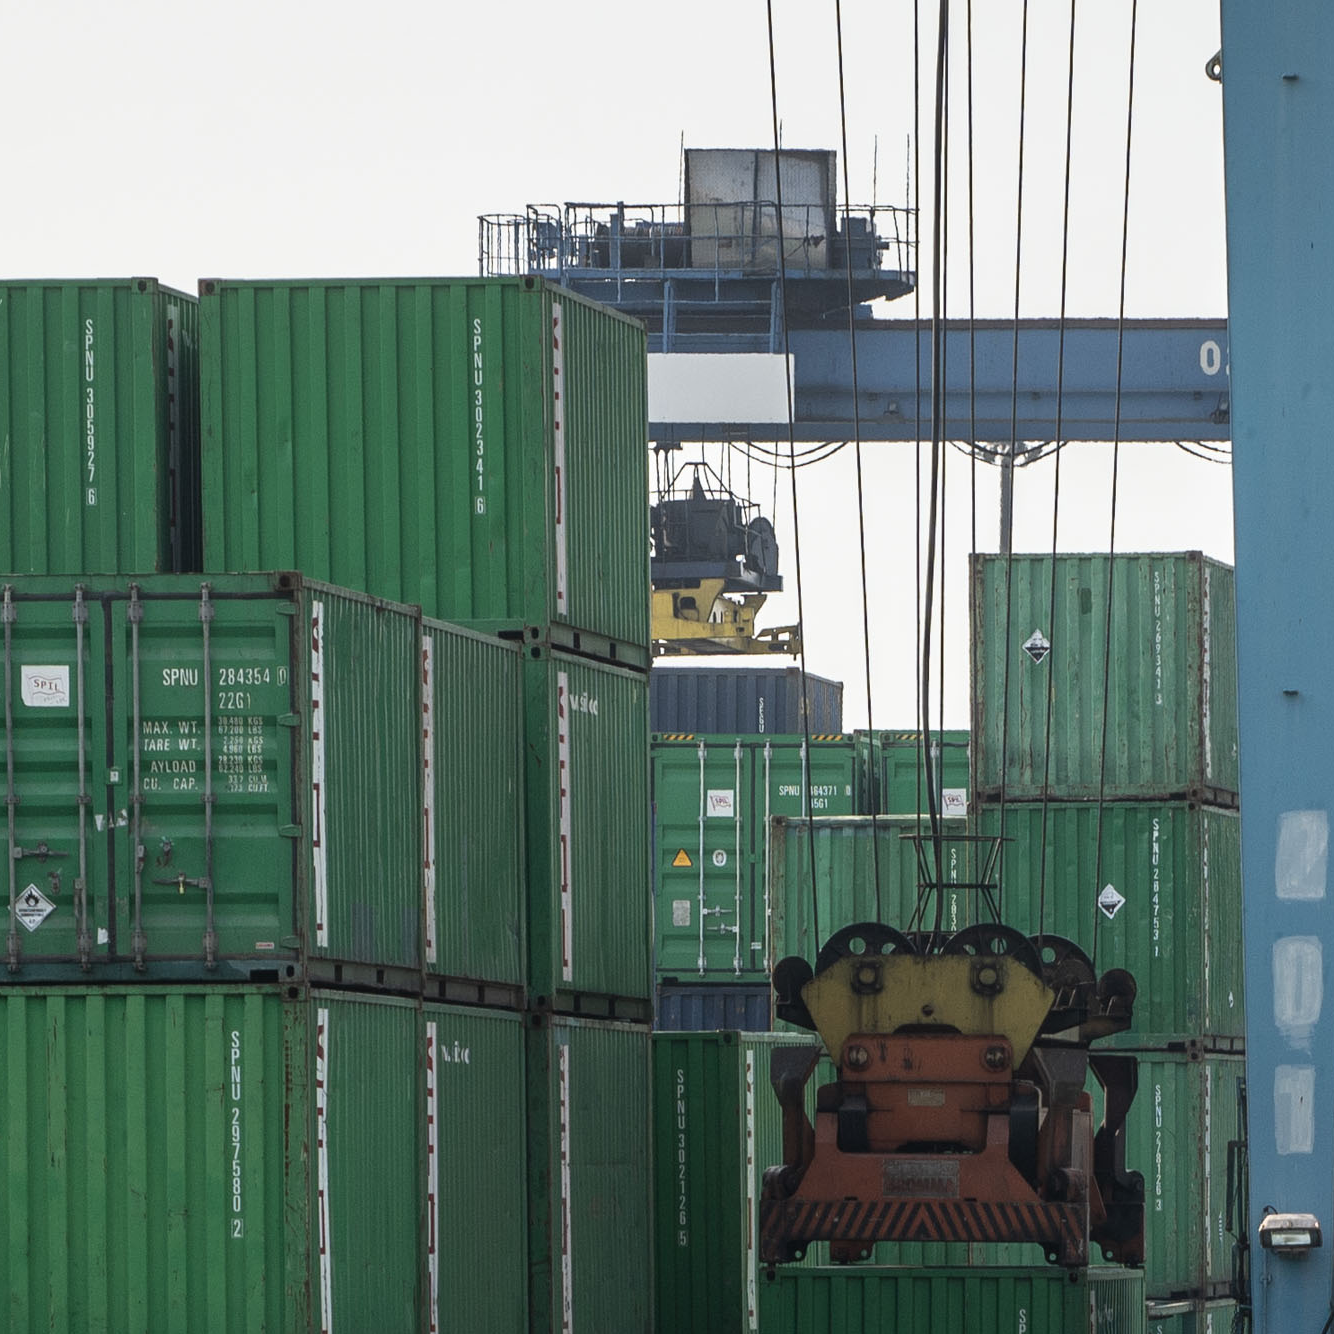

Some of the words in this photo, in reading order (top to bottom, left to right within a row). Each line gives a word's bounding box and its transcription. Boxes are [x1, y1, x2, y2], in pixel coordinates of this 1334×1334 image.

[85, 318, 94, 381] SPNU
[473, 318, 482, 385] SPNU
[1199, 340, 1230, 376] 0
[86, 387, 95, 482] 305927
[475, 390, 484, 491] 302341
[87, 488, 96, 505] 6
[475, 497, 485, 514] 6
[162, 668, 198, 686] SPNU
[219, 668, 270, 686] 284354
[143, 721, 173, 735] MAX.
[178, 721, 201, 735] WT.
[144, 739, 170, 751] TARE
[143, 778, 162, 790] CU.
[173, 778, 198, 790] CAP.
[778, 785, 800, 796] SPNU
[231, 1031, 240, 1101] SPNU
[676, 1069, 685, 1130] SPNU
[232, 1107, 241, 1212] 297580
[678, 1134, 686, 1225] 302126
[232, 1219, 242, 1238] 2
[679, 1230, 687, 1246] 5
